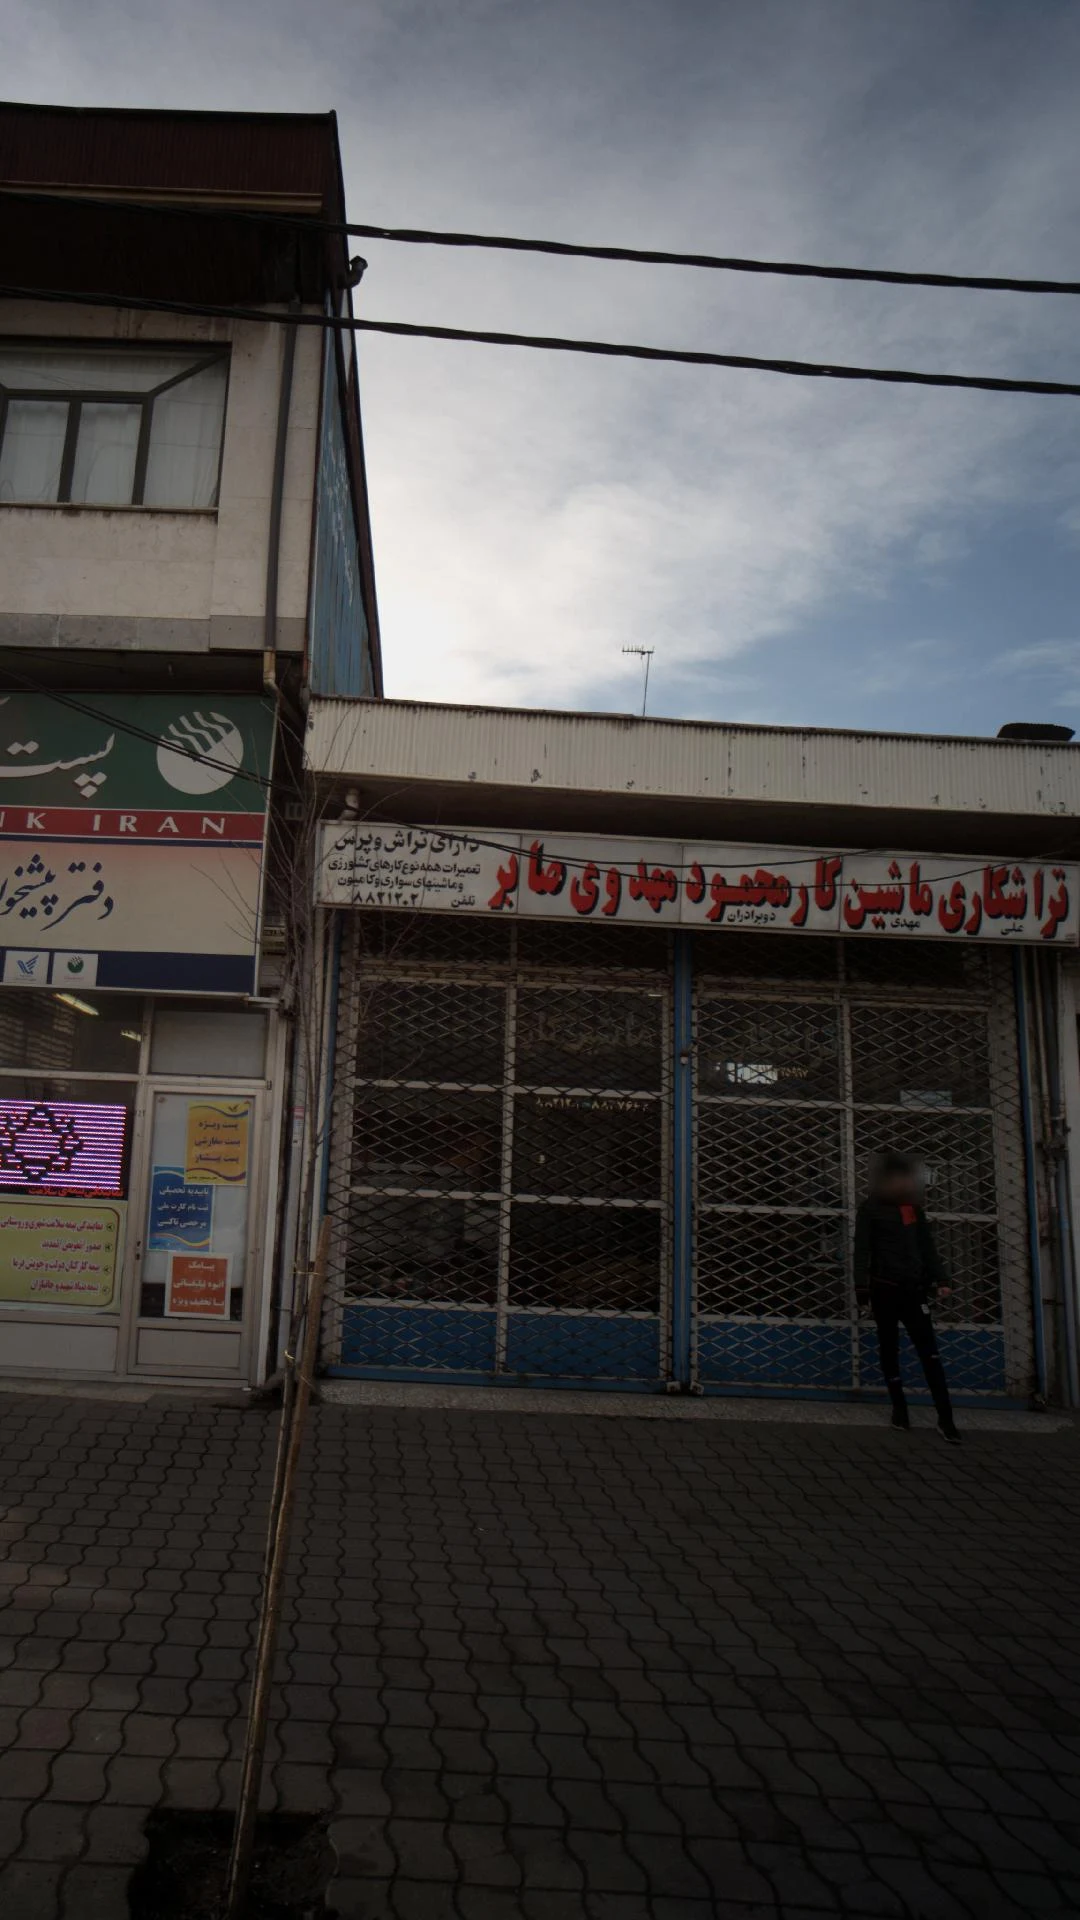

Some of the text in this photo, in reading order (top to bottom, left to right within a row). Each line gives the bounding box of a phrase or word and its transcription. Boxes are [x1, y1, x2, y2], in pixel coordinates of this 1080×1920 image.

[92, 815, 226, 834] IRAN
[385, 830, 428, 855] تراش
[430, 832, 480, 856] دارای
[328, 855, 481, 877] تعمیرات همه نوع کارهای کشاورزی
[337, 874, 375, 887] کامیون
[380, 876, 412, 889] سواری
[487, 839, 1070, 938] تراشکاری ماشین کار محمود مهدوی صابر
[40, 861, 114, 931] دفتر
[450, 894, 476, 908] تلفن
[890, 916, 921, 929] مهدی
[1001, 922, 1025, 935] علی
